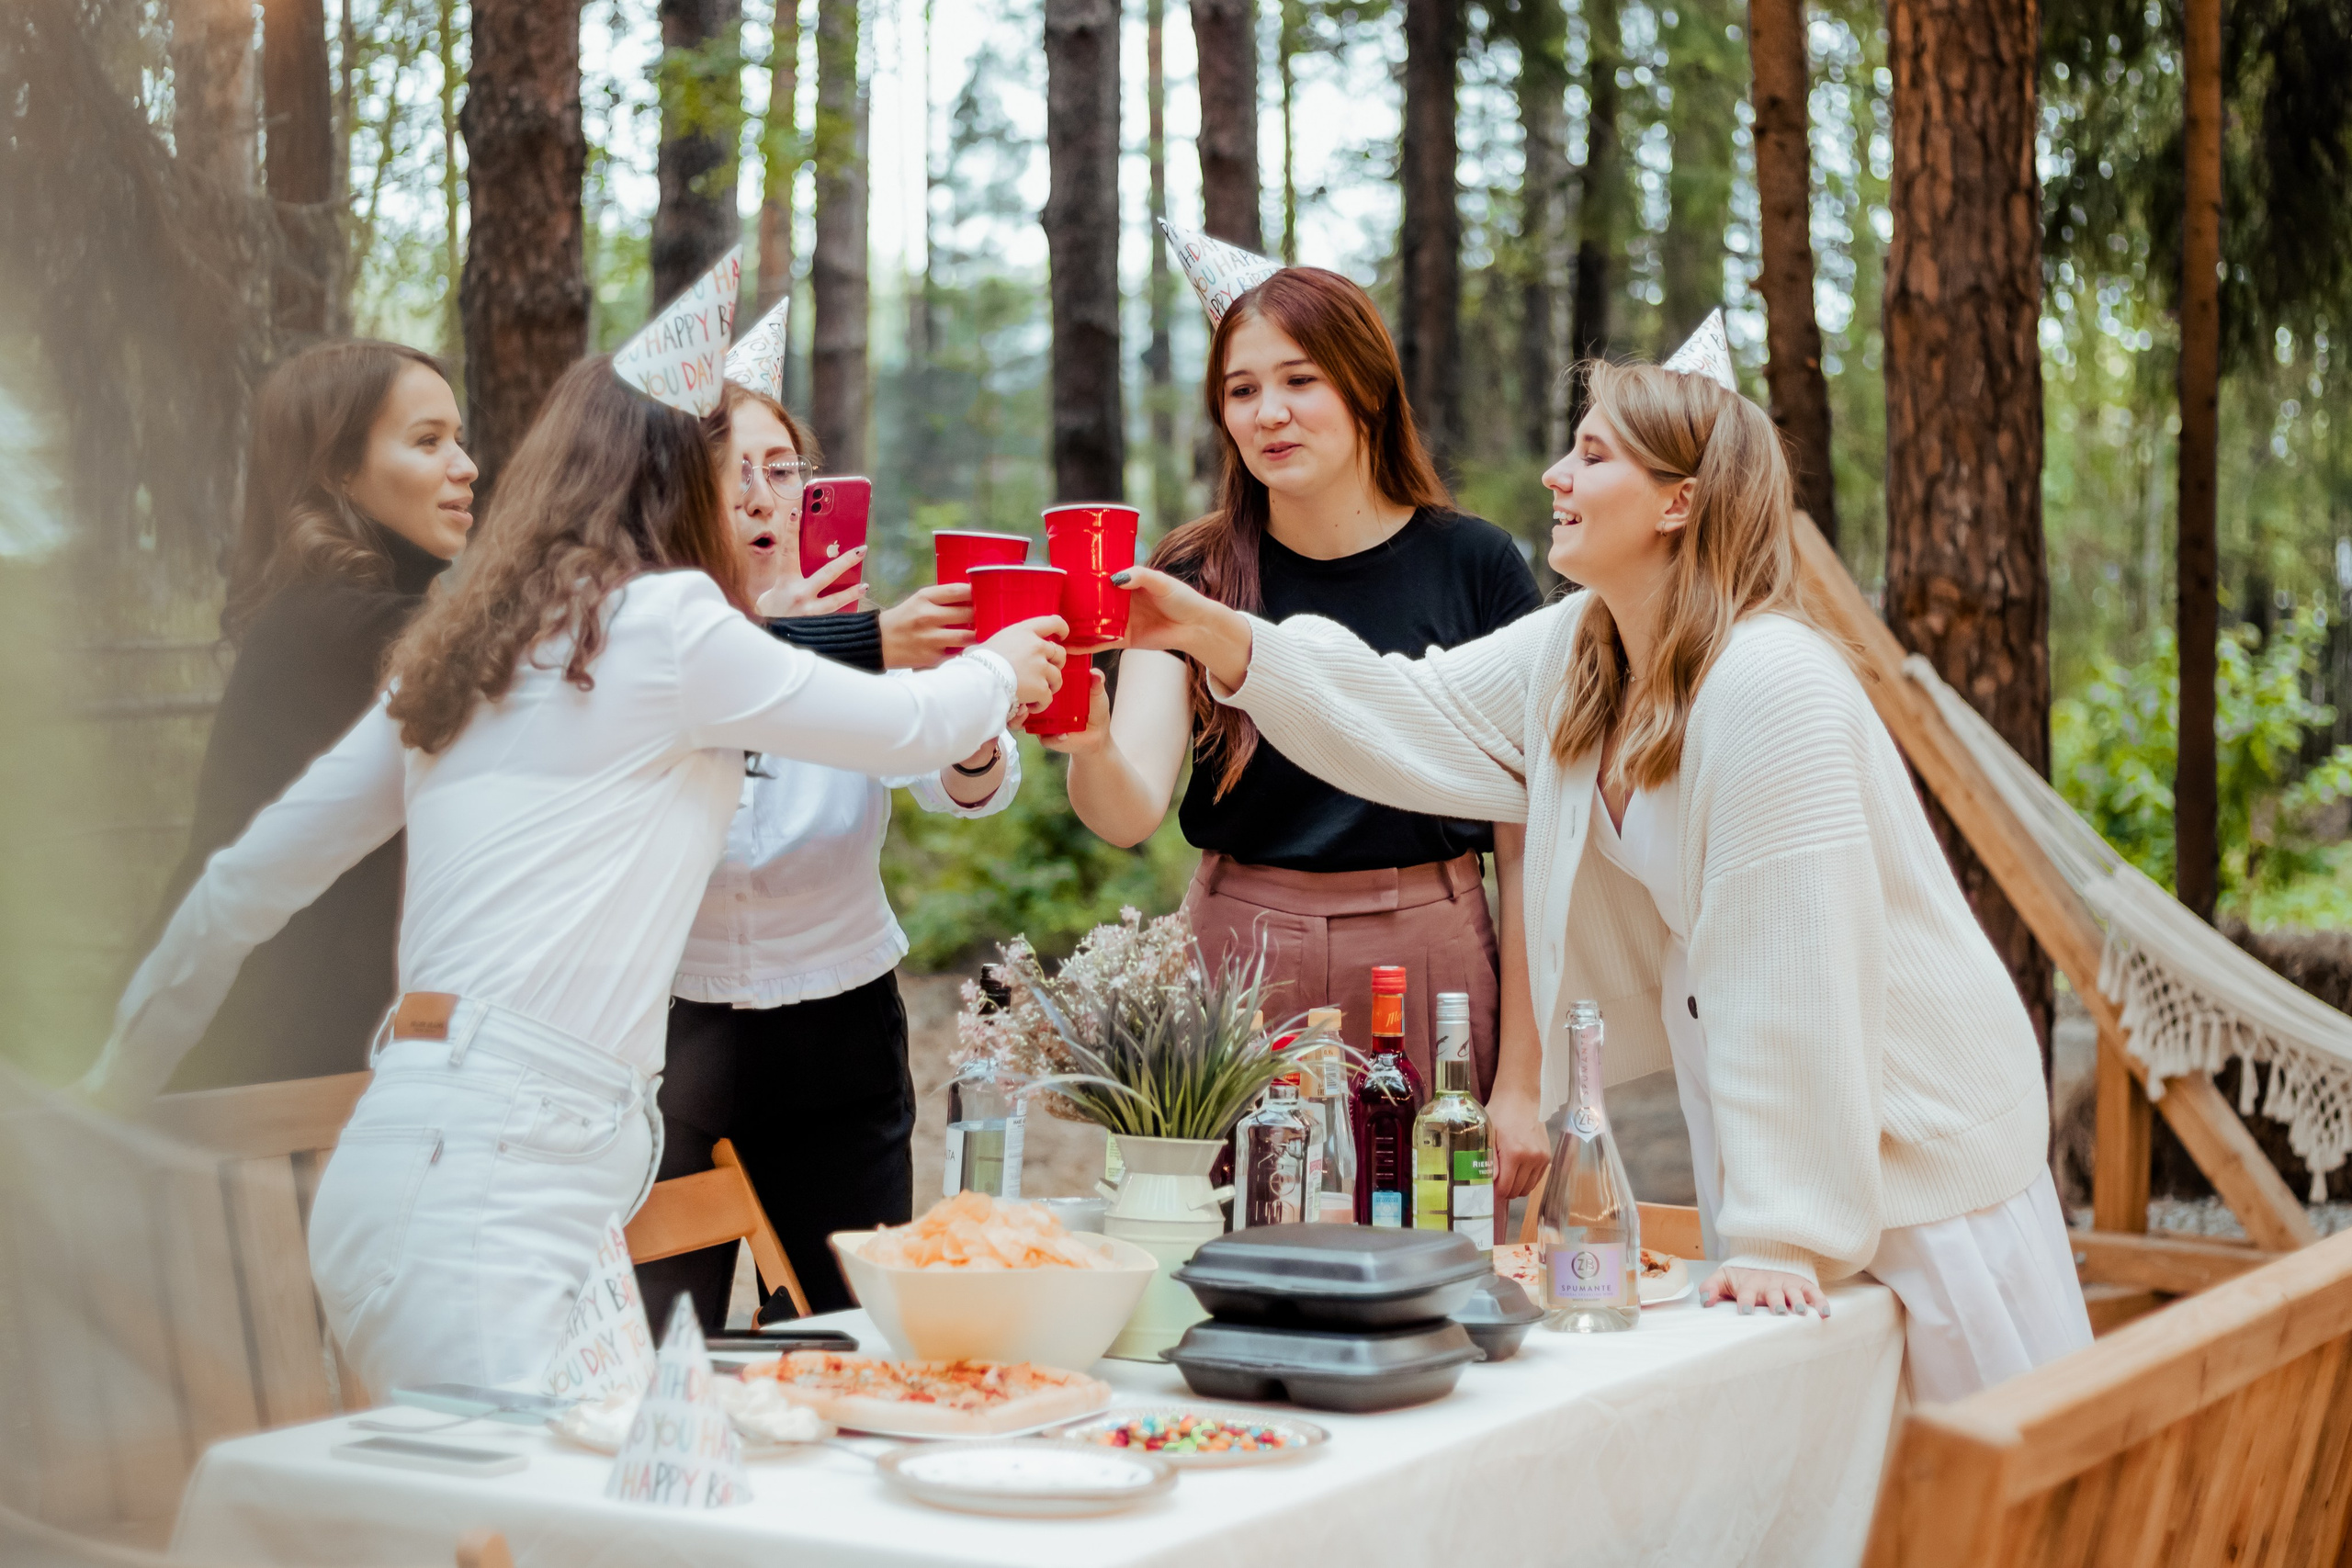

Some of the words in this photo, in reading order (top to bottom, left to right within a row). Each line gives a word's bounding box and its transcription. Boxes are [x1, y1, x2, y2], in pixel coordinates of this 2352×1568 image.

[644, 308, 710, 359] HAPPY
[637, 366, 682, 398] YOU
[681, 350, 715, 392] DAY
[1580, 1032, 1589, 1096] SPUMANTE
[1561, 1284, 1612, 1292] SPUMANTE
[547, 1354, 583, 1398] YOU
[579, 1327, 624, 1378] DAY
[619, 1319, 647, 1359] TO
[619, 1461, 702, 1508] HAPPY
